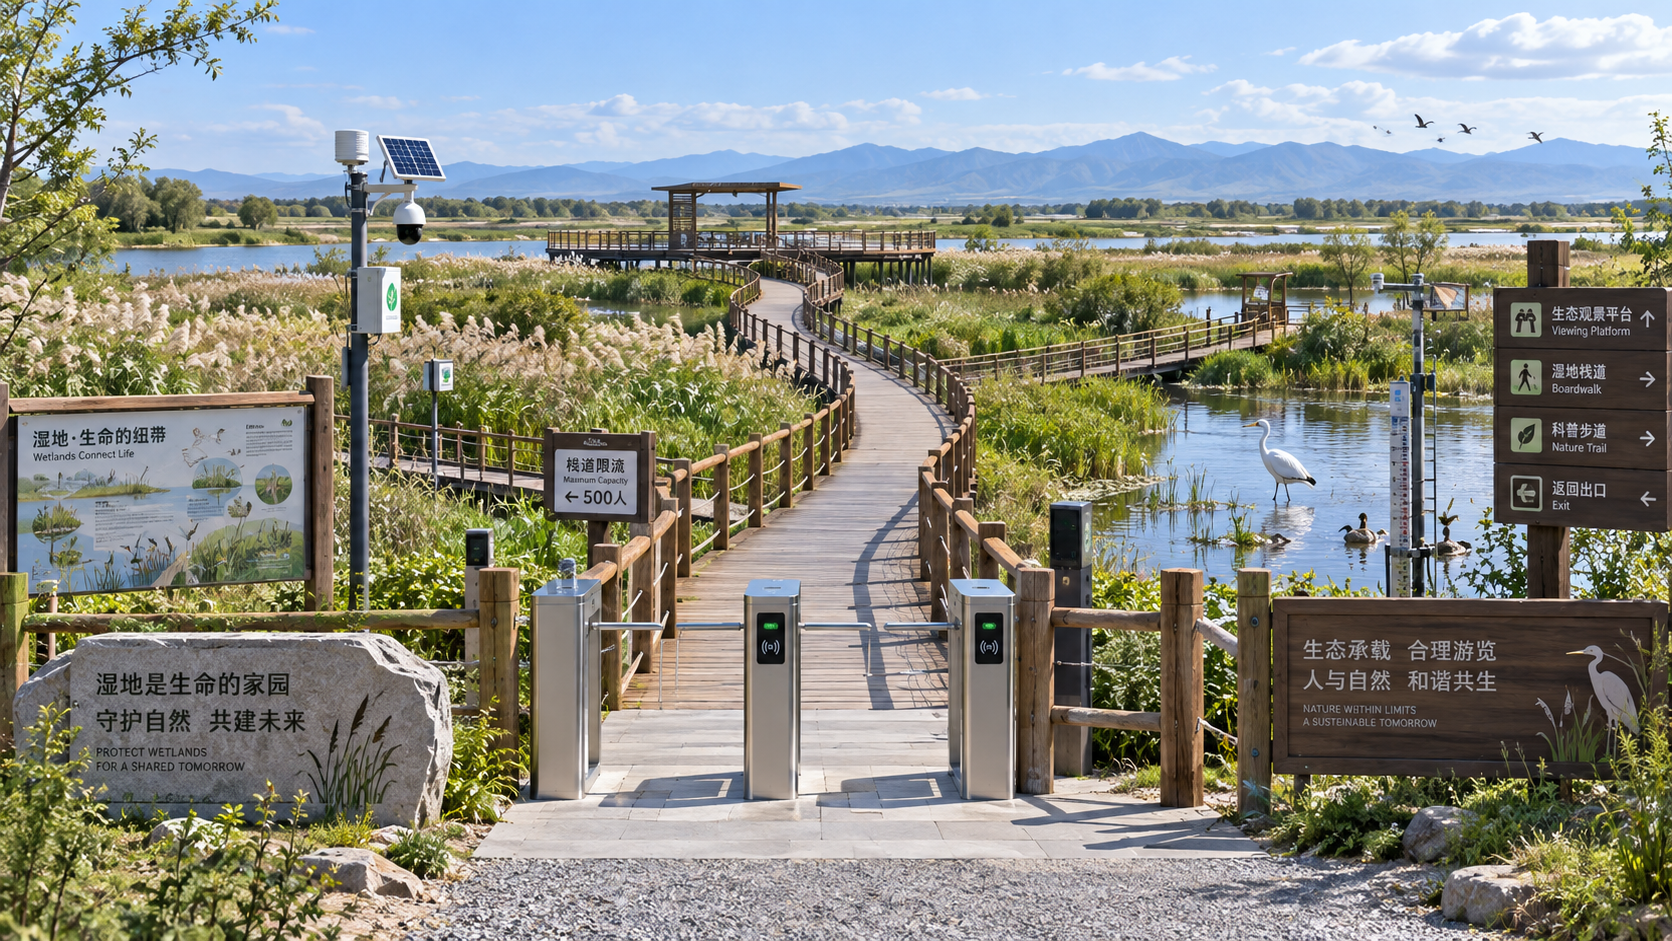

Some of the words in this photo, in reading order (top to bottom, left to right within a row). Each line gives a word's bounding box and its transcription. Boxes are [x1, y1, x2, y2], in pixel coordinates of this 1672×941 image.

[1551, 305, 1633, 323] 生态观景平台
[1551, 325, 1589, 339] Viewing
[1590, 325, 1631, 337] Platform
[1551, 363, 1607, 380] 湿地栈道
[1551, 383, 1602, 395] Boardwalk
[32, 425, 166, 448] 湿地·生命的纽带
[1551, 421, 1607, 439] 科普步道
[32, 451, 77, 462] Wetlands
[78, 449, 116, 460] Connect
[118, 448, 135, 459] Life
[1552, 441, 1585, 453] Nature
[1586, 442, 1607, 454] Trail
[597, 475, 629, 486] Capacity
[1551, 480, 1606, 498] 返回出口
[583, 489, 628, 506] 500人
[1552, 499, 1571, 511] Exit
[1303, 638, 1391, 661] 生态承载
[1407, 639, 1497, 661] 合理游览
[96, 671, 290, 697] 湿地是生命的家园
[1303, 668, 1391, 691] 人与自然
[1407, 669, 1497, 692] 和谐共生
[1303, 704, 1341, 714] NATURE
[1384, 705, 1417, 715] LIMITS
[96, 708, 191, 733] 守护自然
[209, 708, 306, 734] 共建未来
[1302, 717, 1310, 727] A
[1379, 718, 1438, 728] TOMORROW
[96, 747, 145, 758] PROTECT
[147, 747, 208, 758] WETLANDS
[96, 761, 118, 772] FOR
[120, 761, 129, 772] A
[131, 761, 175, 772] SHARED
[178, 761, 246, 772] TOMORROW
